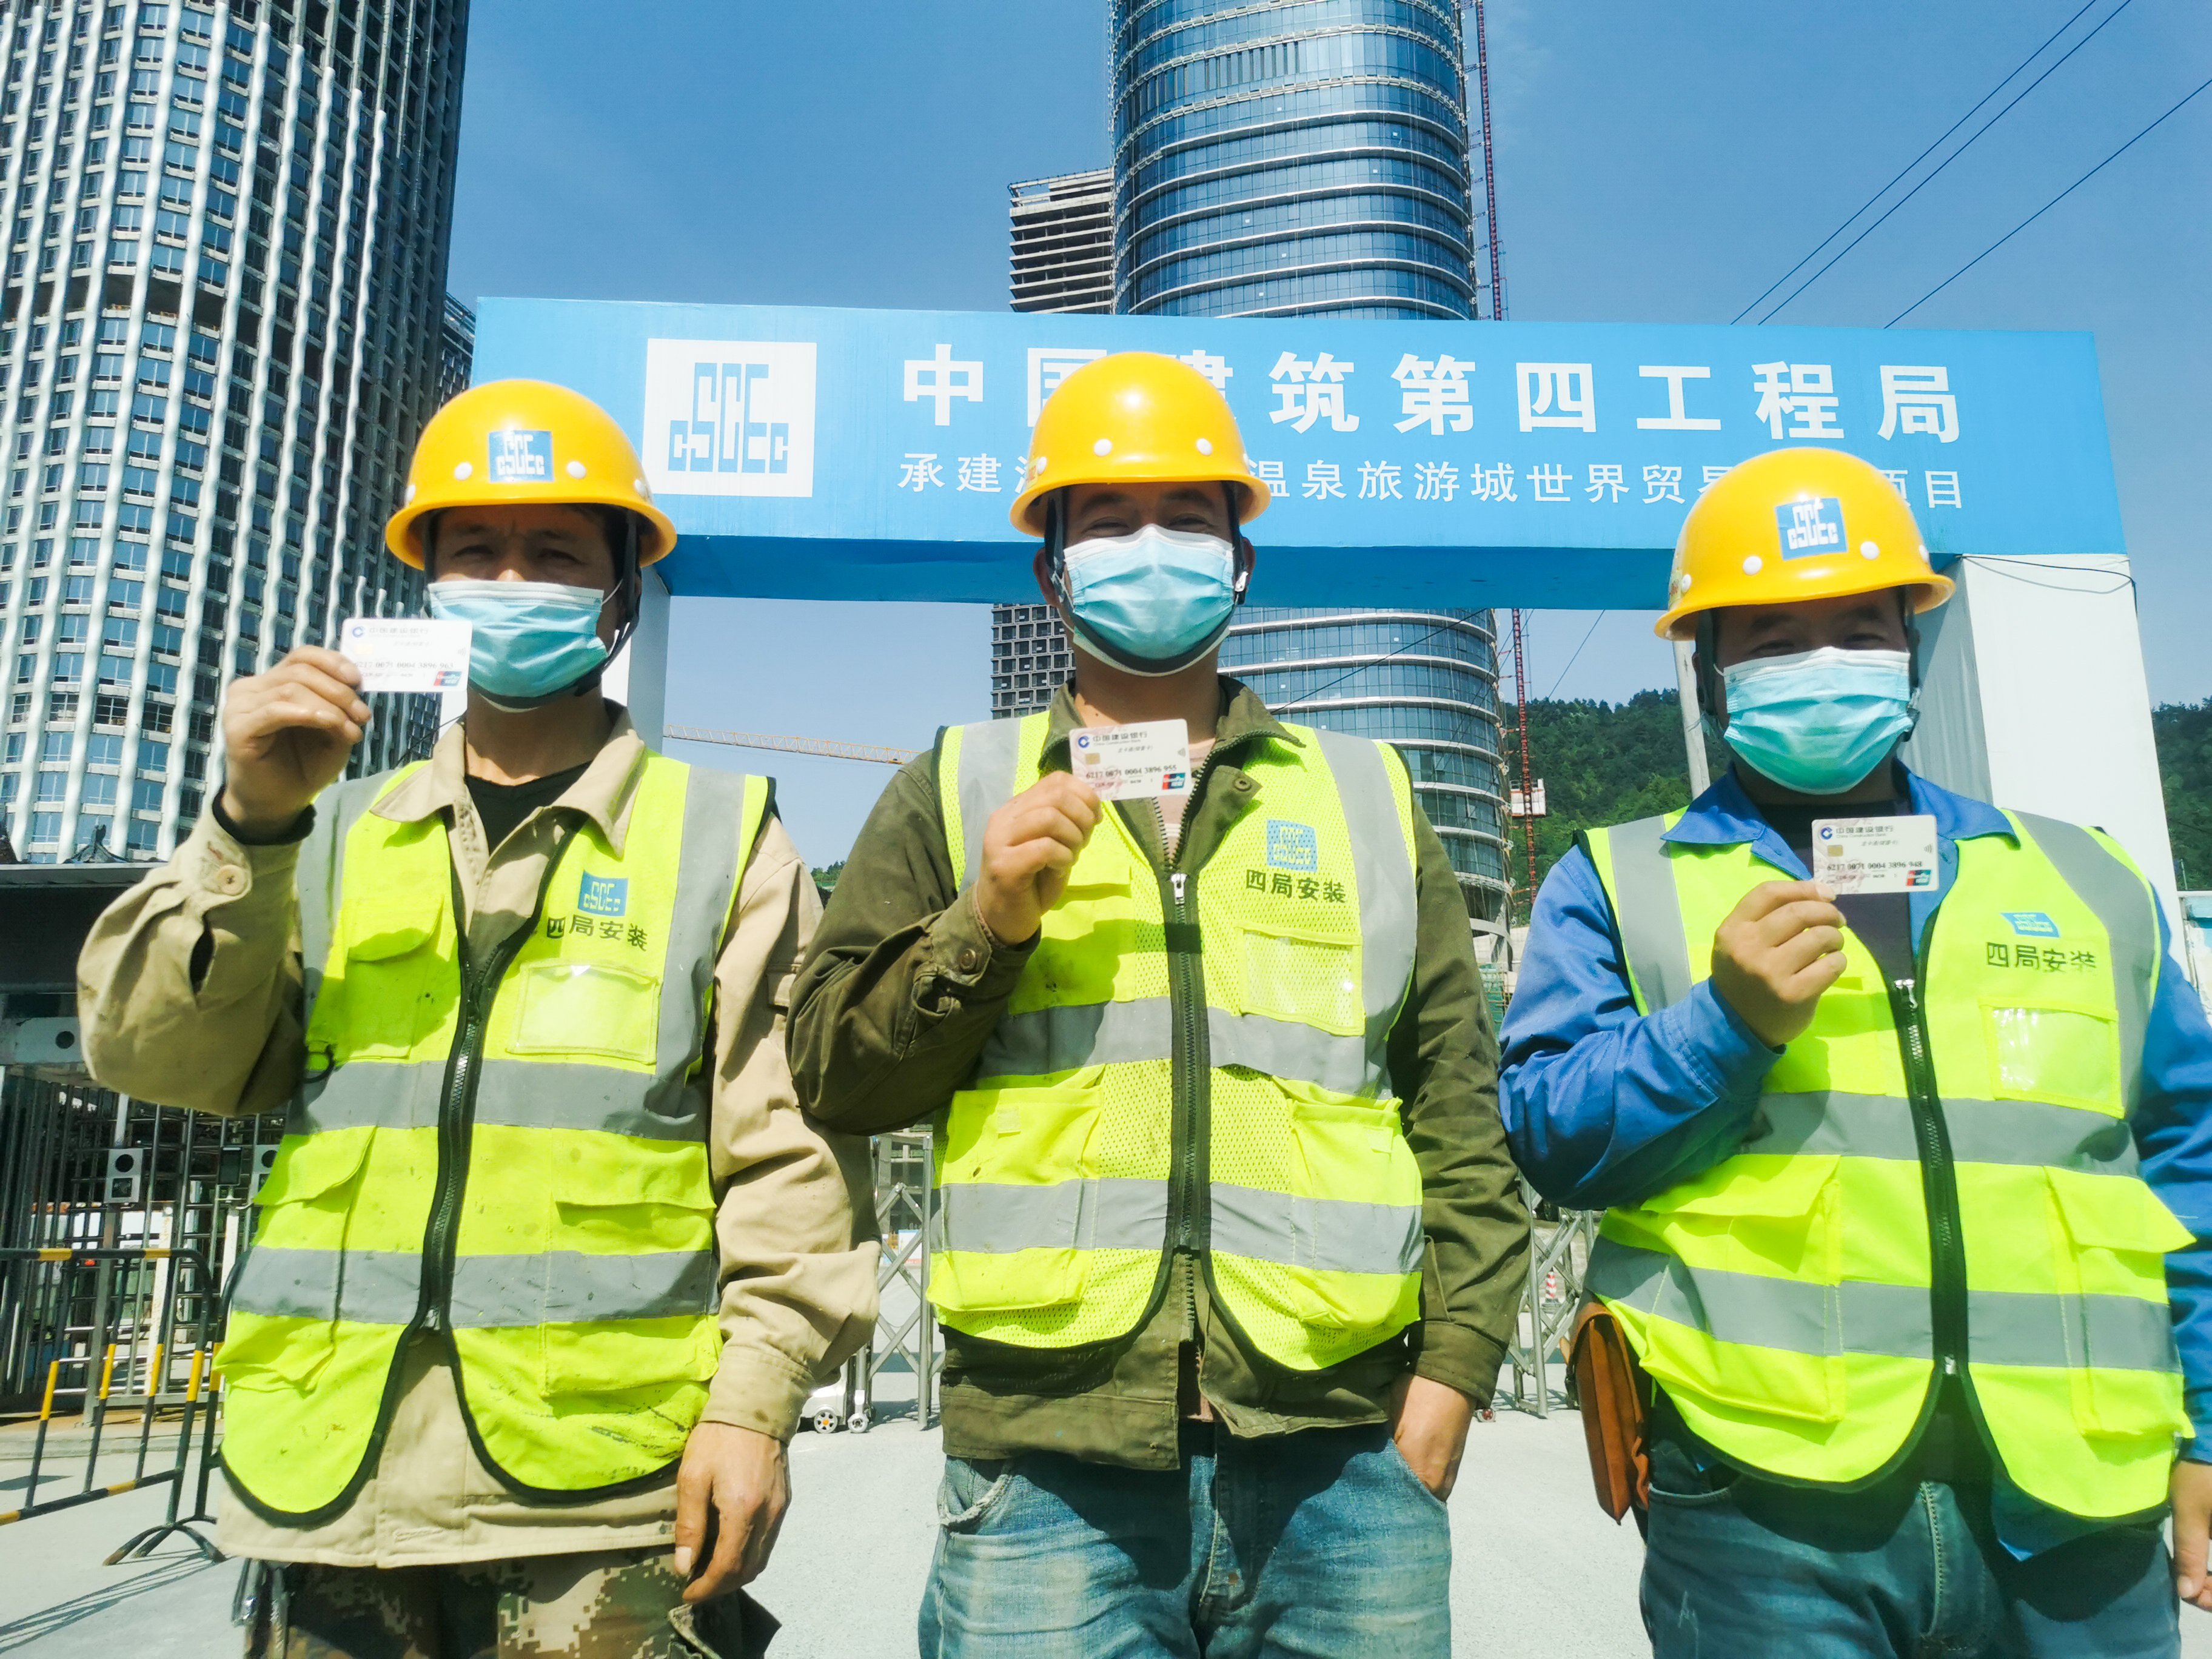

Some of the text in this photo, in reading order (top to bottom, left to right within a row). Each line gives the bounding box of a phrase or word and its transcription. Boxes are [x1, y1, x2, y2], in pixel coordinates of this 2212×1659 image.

[1836, 825, 1893, 834] 中国建设银行
[1246, 869, 1346, 903] 四局安装
[546, 914, 648, 952] 四局安装
[1986, 942, 2097, 973] 四局安装
